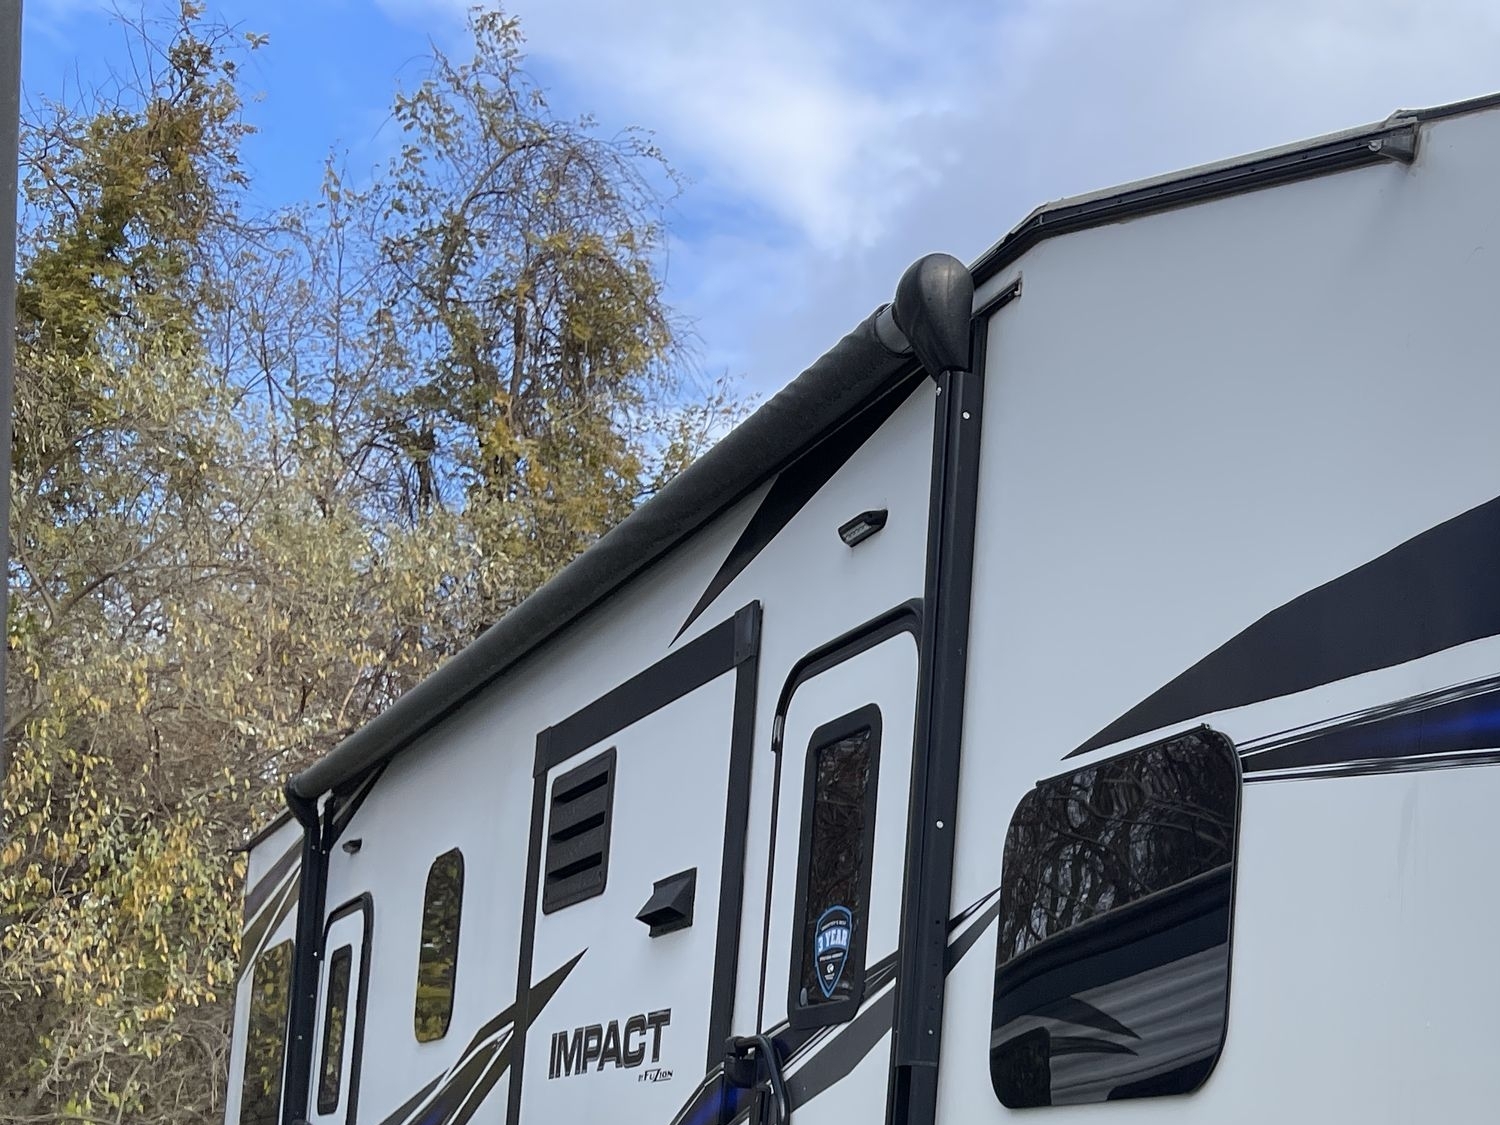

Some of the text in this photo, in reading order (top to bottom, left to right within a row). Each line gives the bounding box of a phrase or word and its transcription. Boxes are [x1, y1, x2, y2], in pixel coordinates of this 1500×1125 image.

[818, 929, 847, 952] 3 YEAR
[548, 1008, 671, 1079] IMPACT
